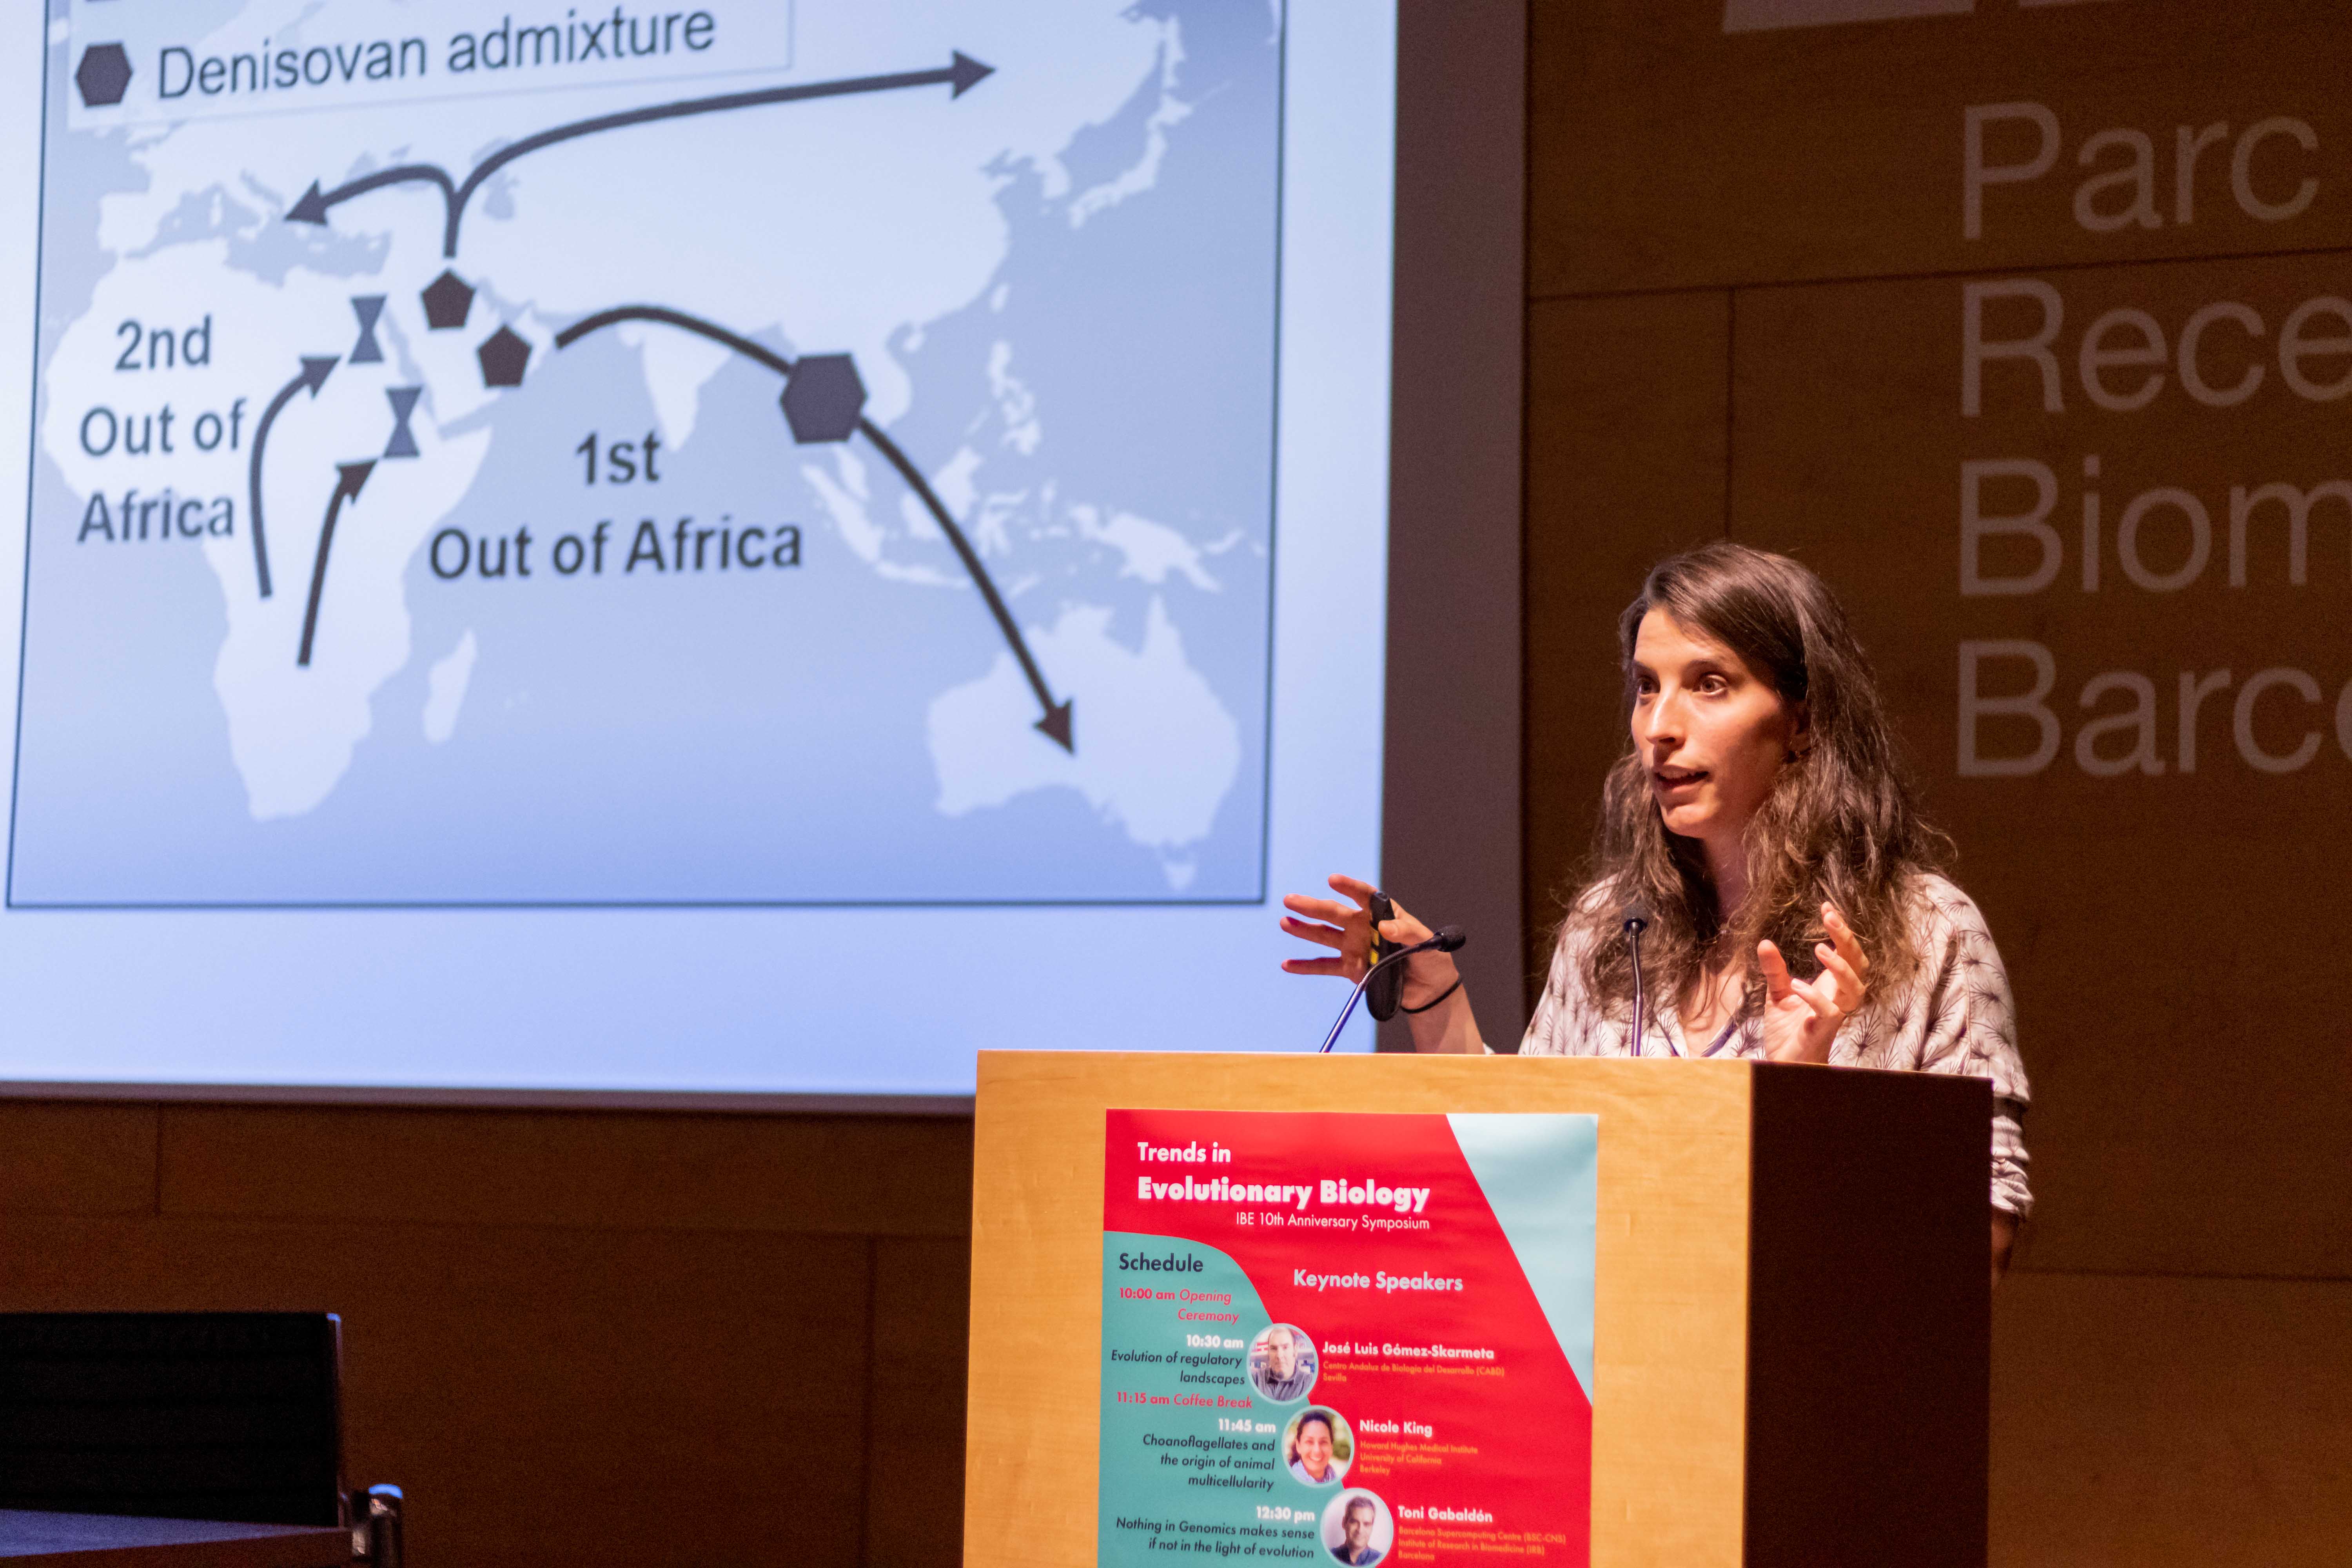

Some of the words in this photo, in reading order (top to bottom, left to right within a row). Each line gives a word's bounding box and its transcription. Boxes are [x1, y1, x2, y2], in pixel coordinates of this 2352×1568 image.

[158, 34, 427, 100] Denisovan
[448, 7, 715, 73] admixture
[1962, 100, 2321, 241] Parc
[116, 316, 212, 371] 2nd
[1961, 278, 2352, 417] Rece
[80, 406, 174, 457] Out
[194, 399, 246, 451] of
[575, 431, 661, 486] 1st
[78, 488, 234, 543] Africa
[430, 524, 532, 580] Out
[552, 523, 610, 575] of
[625, 515, 802, 573] Africa
[1958, 639, 2352, 778] Barc
[1138, 1141, 1206, 1162] Trends
[1212, 1142, 1231, 1162] in
[1138, 1176, 1313, 1210] Evolutionary
[1320, 1179, 1430, 1212] Biology
[1236, 1212, 1255, 1225] IBE
[1259, 1212, 1284, 1226] 10th
[1288, 1213, 1358, 1230] Anniversary
[1362, 1216, 1429, 1231] Symposium
[1119, 1252, 1203, 1272] Schedule
[1294, 1269, 1370, 1291] Keynote
[1376, 1271, 1463, 1293] Speakers
[1120, 1288, 1152, 1299] 10:00
[1156, 1291, 1175, 1300] am
[1180, 1289, 1231, 1305] Opening
[1178, 1308, 1239, 1325] Ceremony
[1187, 1335, 1220, 1348] 10:30
[1224, 1339, 1243, 1348] am
[1323, 1341, 1350, 1354] José
[1355, 1343, 1378, 1354] Luis
[1383, 1343, 1494, 1359] Gómez-Skarmeta
[1112, 1350, 1162, 1363] Evolution
[1166, 1351, 1178, 1363] of
[1180, 1352, 1242, 1368] regulatory
[1323, 1361, 1346, 1370] Centro
[1349, 1362, 1379, 1370] Andaluz
[1424, 1364, 1434, 1372] del
[1437, 1365, 1474, 1375] Desarrollo
[1180, 1370, 1245, 1387] landscapes
[1323, 1373, 1347, 1382] Sevilla
[1117, 1392, 1146, 1404] 11:15
[1150, 1396, 1169, 1405] am
[1174, 1394, 1213, 1407] Coffee
[1217, 1394, 1252, 1408] Break
[1218, 1418, 1251, 1432] 11:45
[1256, 1423, 1276, 1433] am
[1360, 1419, 1399, 1433] Nicole
[1404, 1421, 1432, 1437] King
[1143, 1434, 1248, 1451] Choanoflagellates
[1252, 1439, 1275, 1451] and
[1360, 1441, 1389, 1450] Howard
[1391, 1442, 1417, 1452] Hughes
[1420, 1444, 1448, 1452] Medical
[1450, 1445, 1478, 1454] Institute
[1161, 1453, 1178, 1465] the
[1182, 1455, 1215, 1470] origin
[1219, 1456, 1232, 1468] of
[1234, 1458, 1274, 1470] animal
[1361, 1454, 1394, 1463] University
[1406, 1455, 1442, 1465] California
[1360, 1465, 1390, 1475] Berkeley
[1189, 1474, 1274, 1492] multicellularity
[1256, 1505, 1291, 1519] 12:30
[1294, 1510, 1315, 1523] pm
[1398, 1505, 1423, 1519] Toni
[1428, 1507, 1492, 1523] Gabaldón
[1116, 1517, 1161, 1533] Nothing
[1165, 1519, 1175, 1531] in
[1179, 1521, 1236, 1535] Genomics
[1240, 1523, 1278, 1537] makes
[1282, 1529, 1314, 1539] sense
[1399, 1527, 1435, 1537] Barcelona
[1437, 1528, 1495, 1541] Supercomputing
[1498, 1531, 1521, 1541] Centre
[1149, 1537, 1157, 1549] if
[1159, 1540, 1177, 1550] not
[1181, 1540, 1191, 1551] in
[1195, 1541, 1212, 1553] the
[1216, 1541, 1240, 1557] light
[1244, 1543, 1256, 1555] of
[1259, 1546, 1314, 1558] evolution
[1399, 1539, 1426, 1548] Institute
[1428, 1540, 1435, 1549] of
[1437, 1541, 1469, 1550] Research
[1472, 1543, 1478, 1551] in
[1481, 1542, 1524, 1553] Biomedicine
[1398, 1551, 1435, 1560] Barcelona
